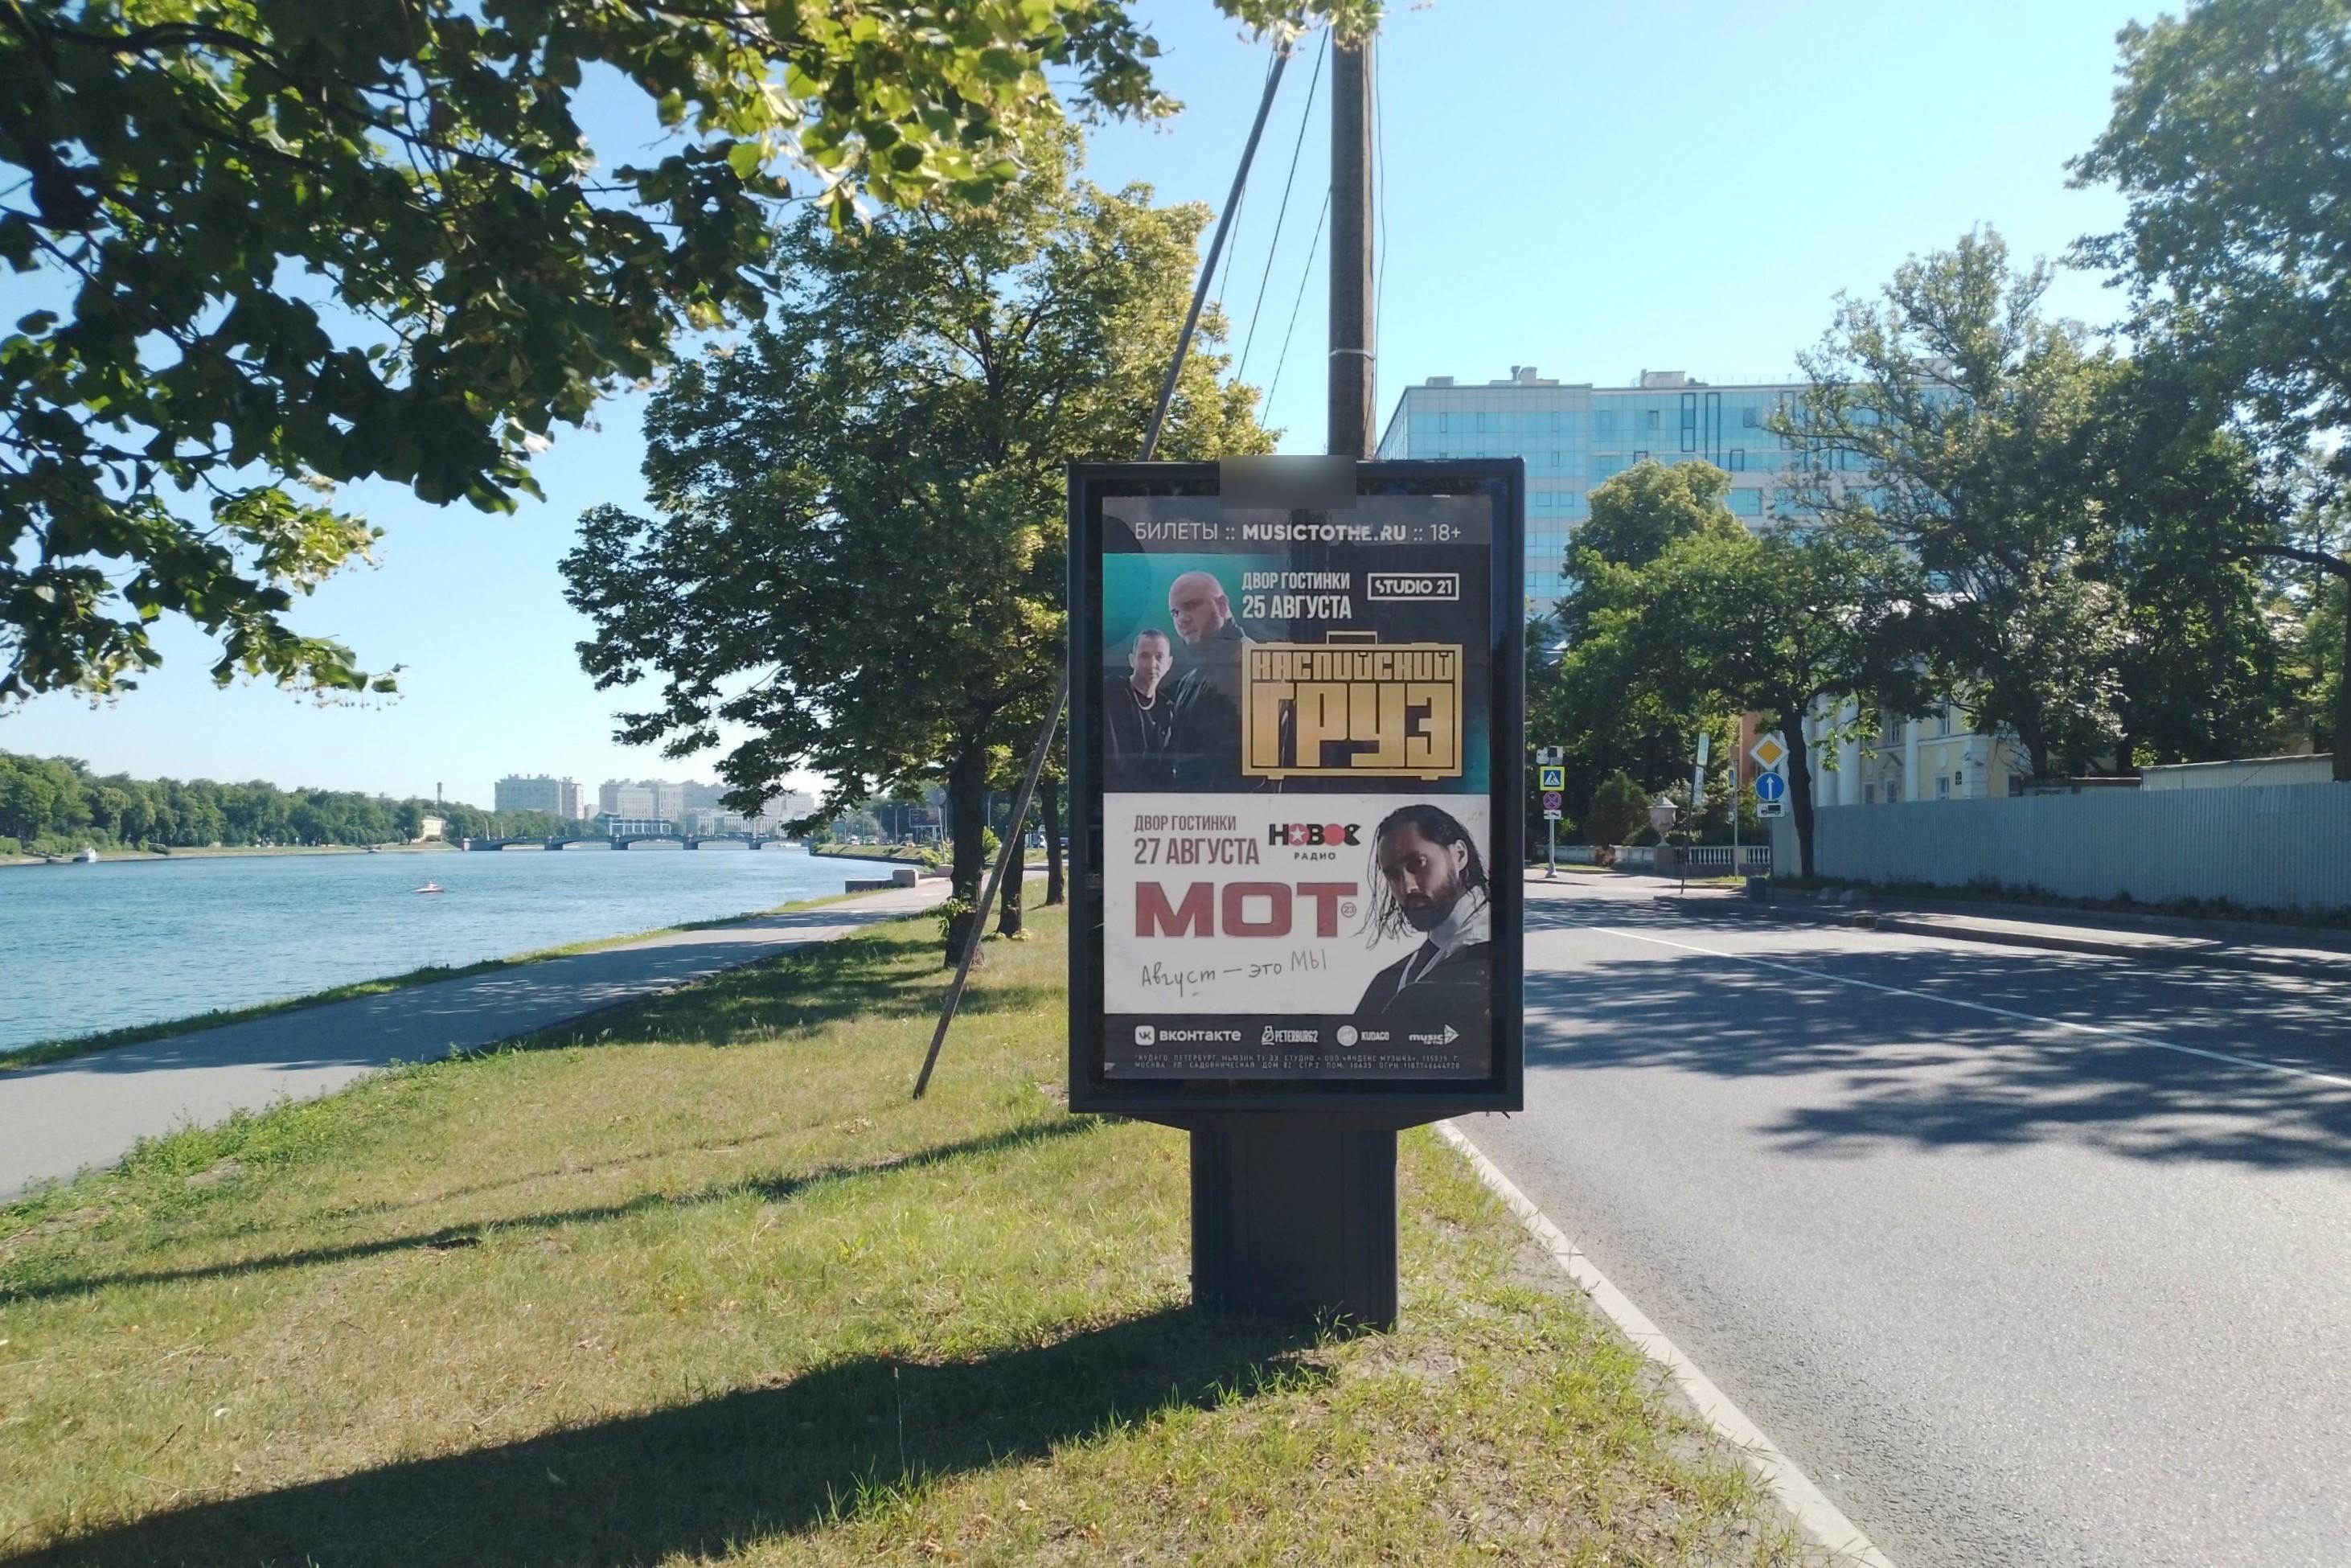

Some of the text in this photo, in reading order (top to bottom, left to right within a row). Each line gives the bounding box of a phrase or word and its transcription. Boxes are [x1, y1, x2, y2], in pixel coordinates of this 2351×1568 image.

[1134, 522, 1218, 540] БИЛЕТЫ
[1242, 523, 1406, 542] MUSICTOTHE.RU
[1430, 523, 1462, 542] 18+
[1241, 572, 1351, 591] ДВОР ГОСТИНКИ
[1374, 579, 1452, 594] STUDIO 21
[1241, 594, 1352, 619] 25 АВГУСТА
[1251, 651, 1455, 681] КАСПИЙСКИЙ
[1251, 682, 1455, 768] ГРУЗ
[1134, 815, 1237, 832] ДВОР ГОСТИНКИ
[1268, 823, 1362, 847] НОВОЕ
[1134, 837, 1260, 865] 27 АВГУСТА
[1293, 852, 1337, 861] РАДИО
[1134, 880, 1359, 938] МОТ
[1141, 961, 1216, 998] Август
[1248, 963, 1282, 979] это
